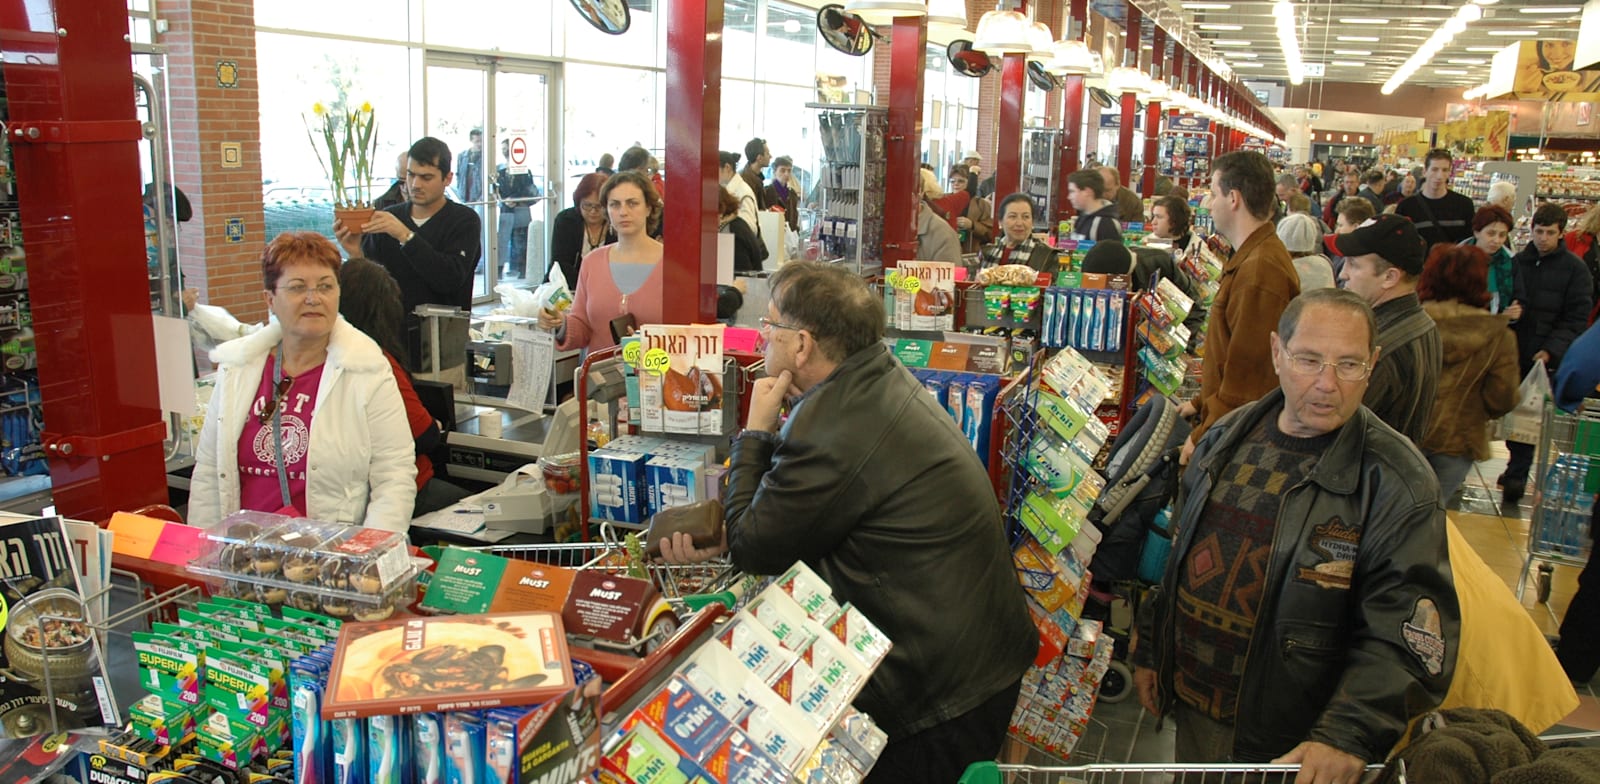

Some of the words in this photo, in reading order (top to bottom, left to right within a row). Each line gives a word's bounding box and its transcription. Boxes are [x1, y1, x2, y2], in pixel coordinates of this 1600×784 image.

[694, 335, 718, 359] דרך
[33, 531, 67, 581] דרך
[182, 690, 198, 703] 200
[800, 683, 829, 712] Orbit
[250, 712, 266, 726] 200
[673, 704, 713, 738] Orbit
